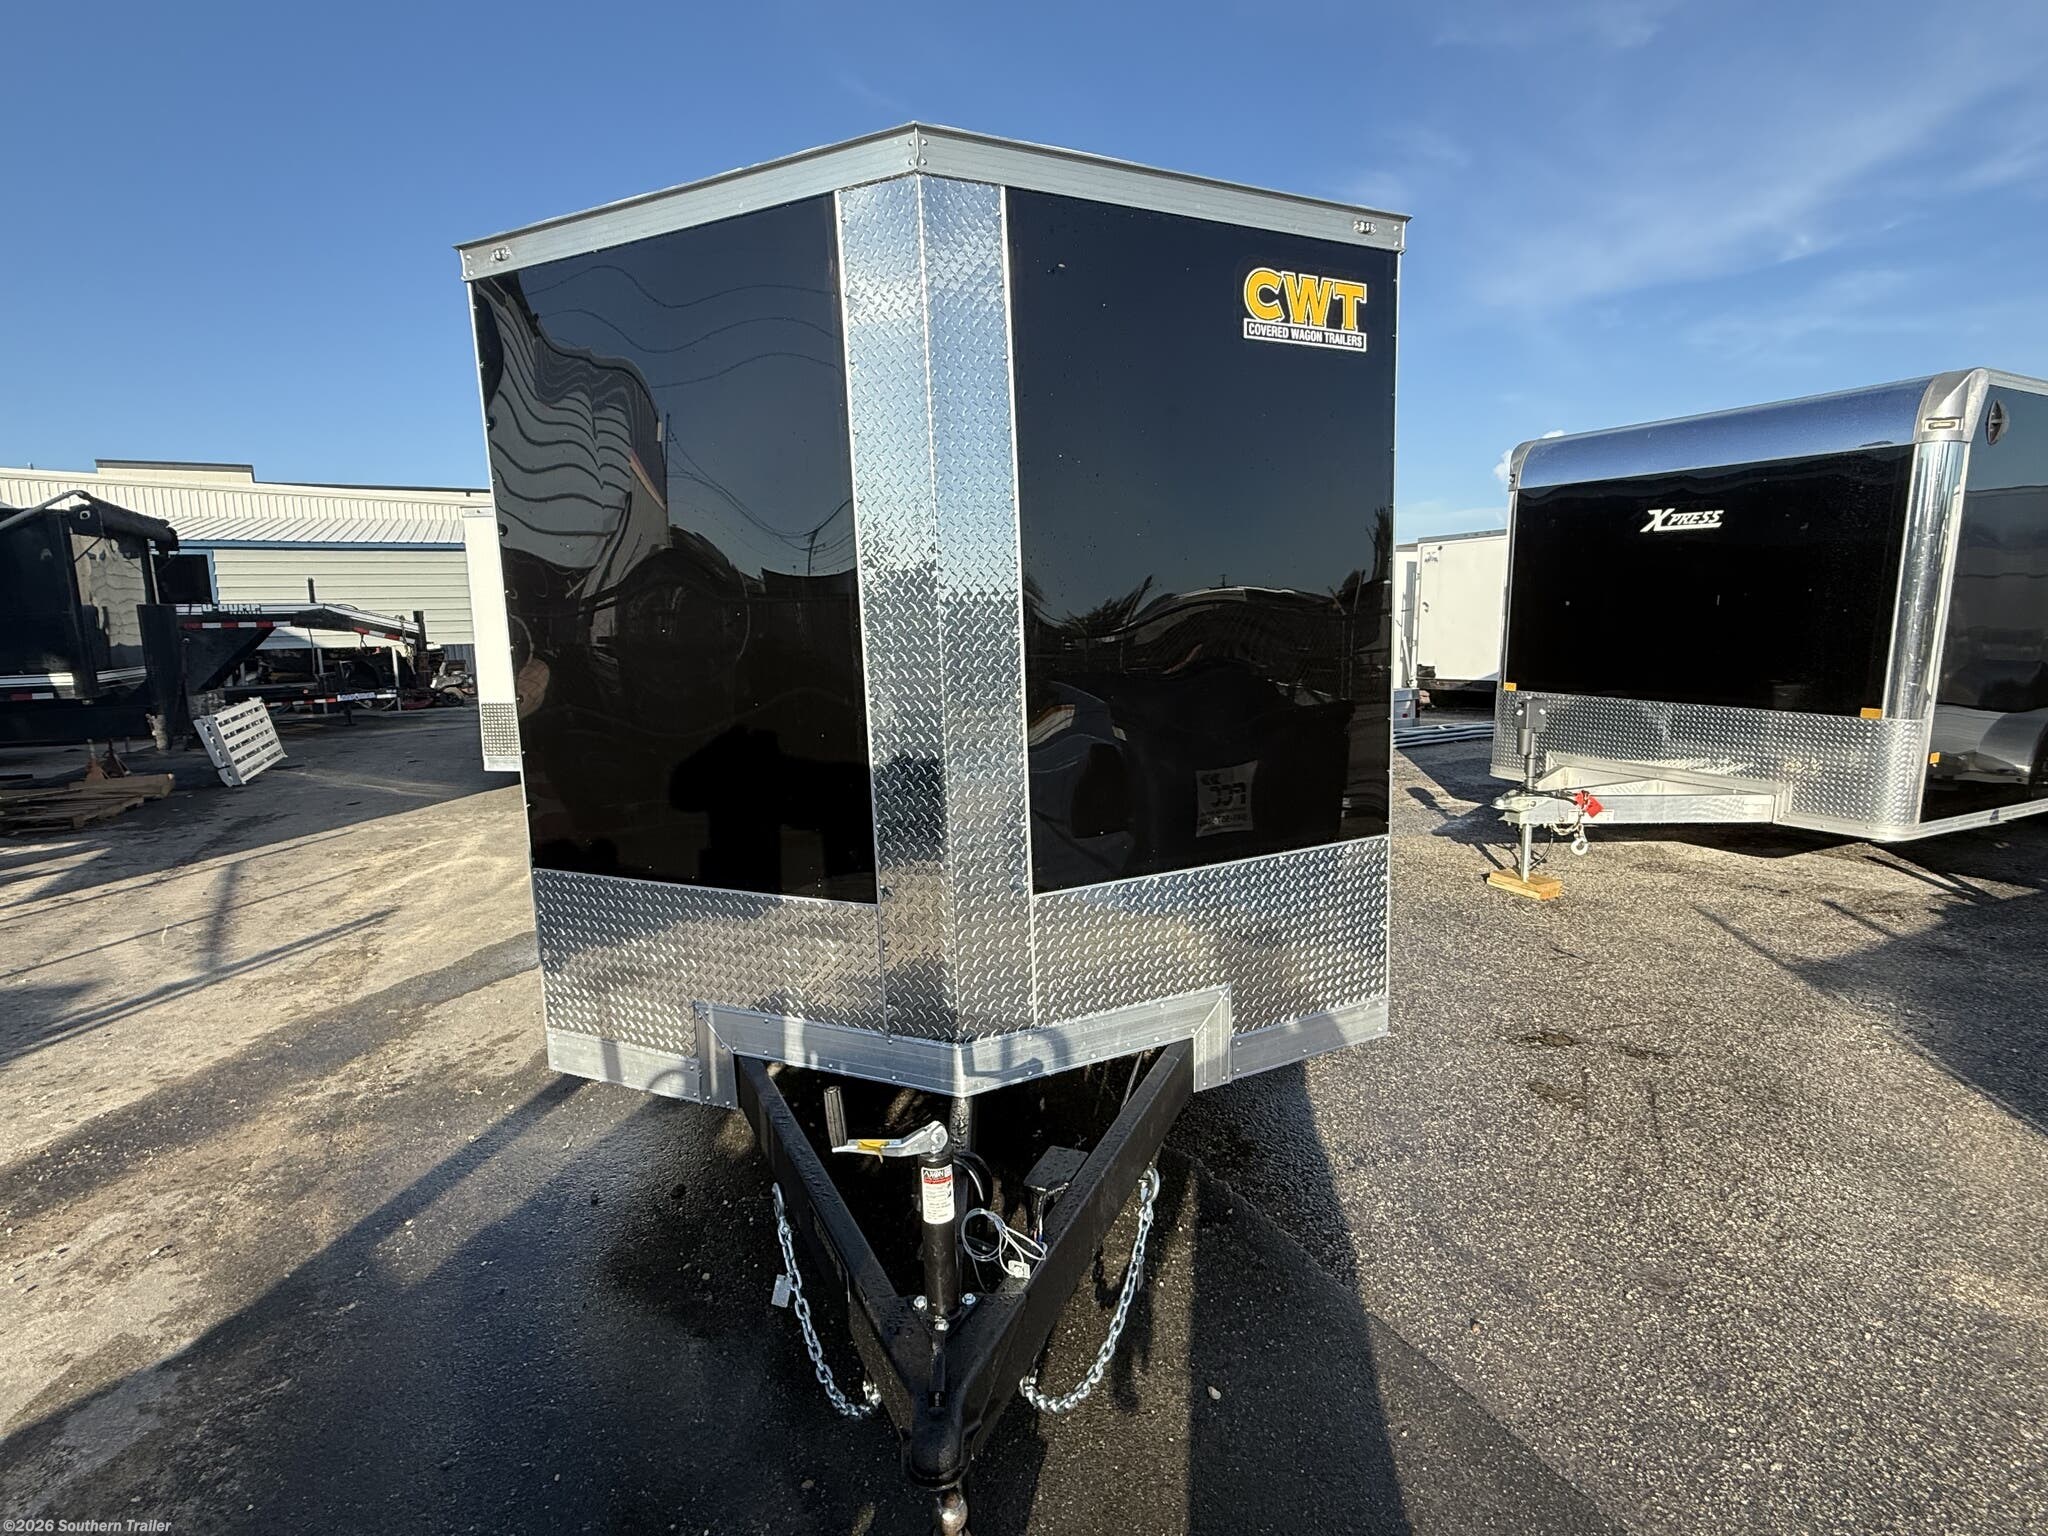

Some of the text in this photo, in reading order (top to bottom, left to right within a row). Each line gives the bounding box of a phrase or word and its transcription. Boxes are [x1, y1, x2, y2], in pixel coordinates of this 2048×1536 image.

[1244, 267, 1367, 331] CWT
[1248, 322, 1363, 348] COVERED WAGON TRAILERS
[1640, 508, 1724, 533] XPRESS
[202, 603, 261, 612] U-DUMP
